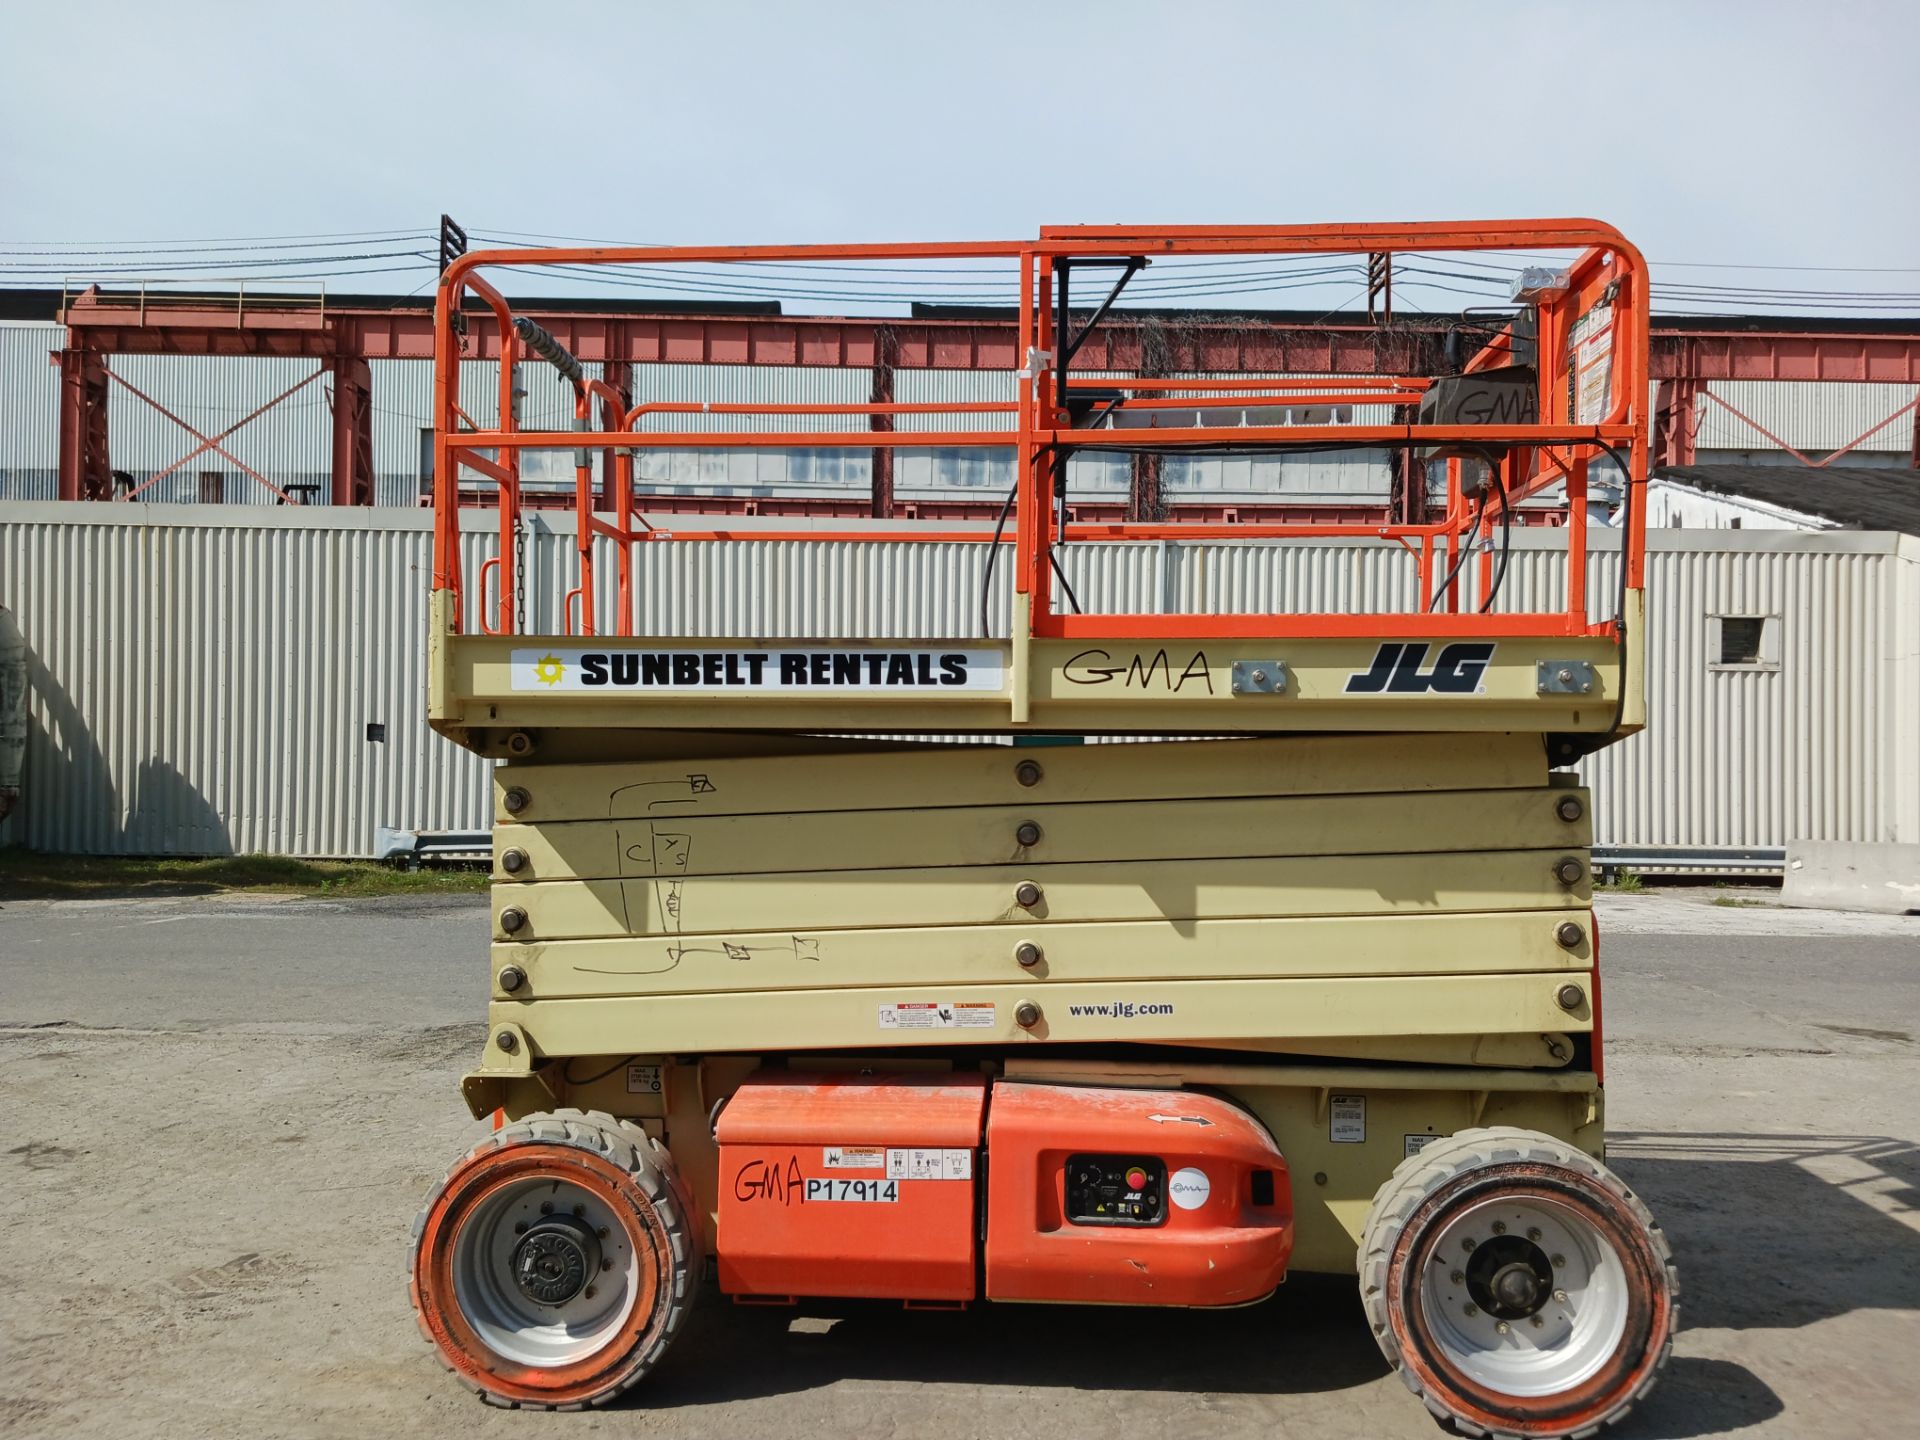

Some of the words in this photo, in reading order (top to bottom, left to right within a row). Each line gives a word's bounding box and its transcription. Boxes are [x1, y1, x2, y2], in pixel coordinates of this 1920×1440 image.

[581, 653, 768, 686] SUNBELT
[780, 653, 968, 686] RENTALS
[1063, 649, 1213, 696] GMA
[1346, 643, 1495, 693] JLG
[1070, 1002, 1173, 1018] www.jlg.com
[735, 1155, 804, 1207] GMA
[807, 1179, 897, 1202] P17914
[1123, 1192, 1142, 1200] JLG
